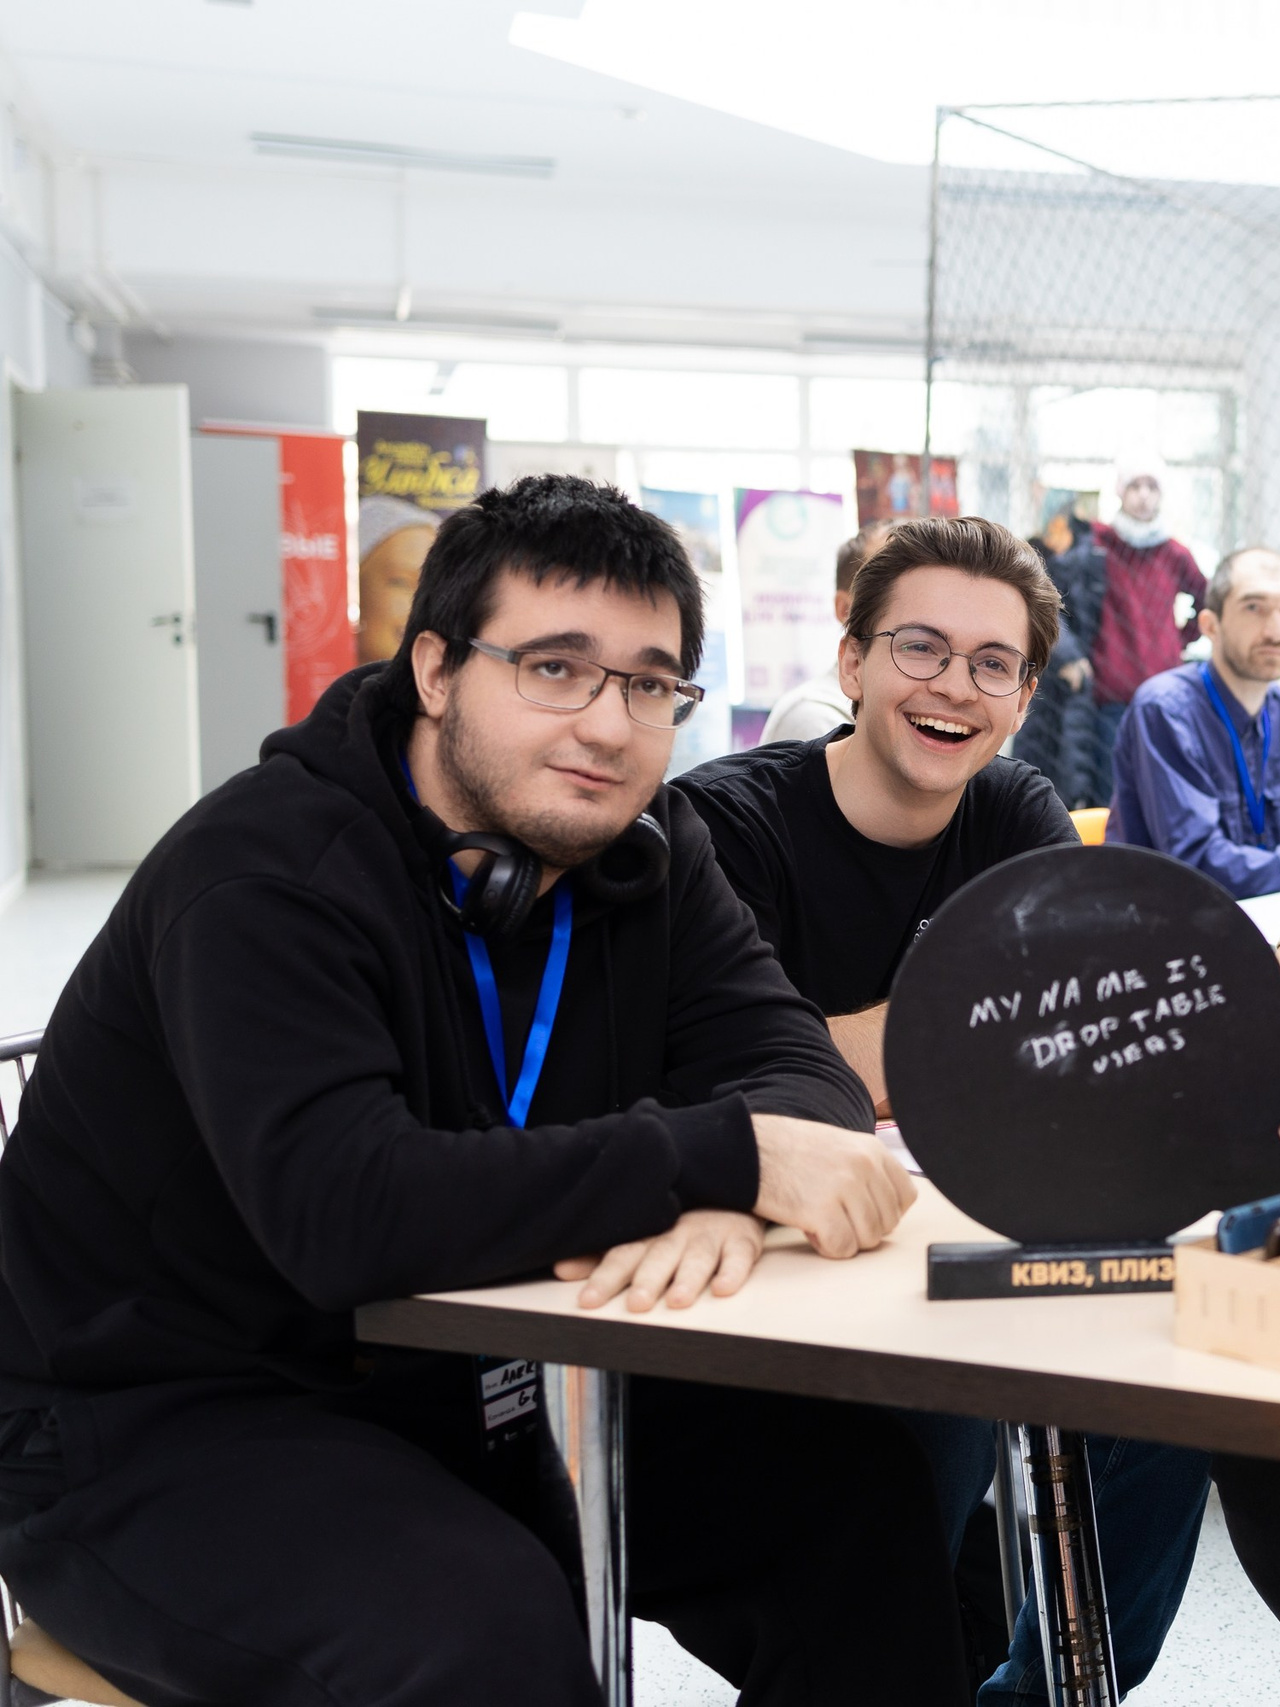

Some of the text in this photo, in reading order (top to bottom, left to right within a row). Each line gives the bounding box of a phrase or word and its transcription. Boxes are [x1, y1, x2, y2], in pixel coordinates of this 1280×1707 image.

[969, 990, 1022, 1028] MY
[1165, 954, 1208, 985] IS
[1030, 983, 1227, 1069] DROP TABLE
[1011, 1256, 1175, 1289] КВИЗ, ПЛИЗ
